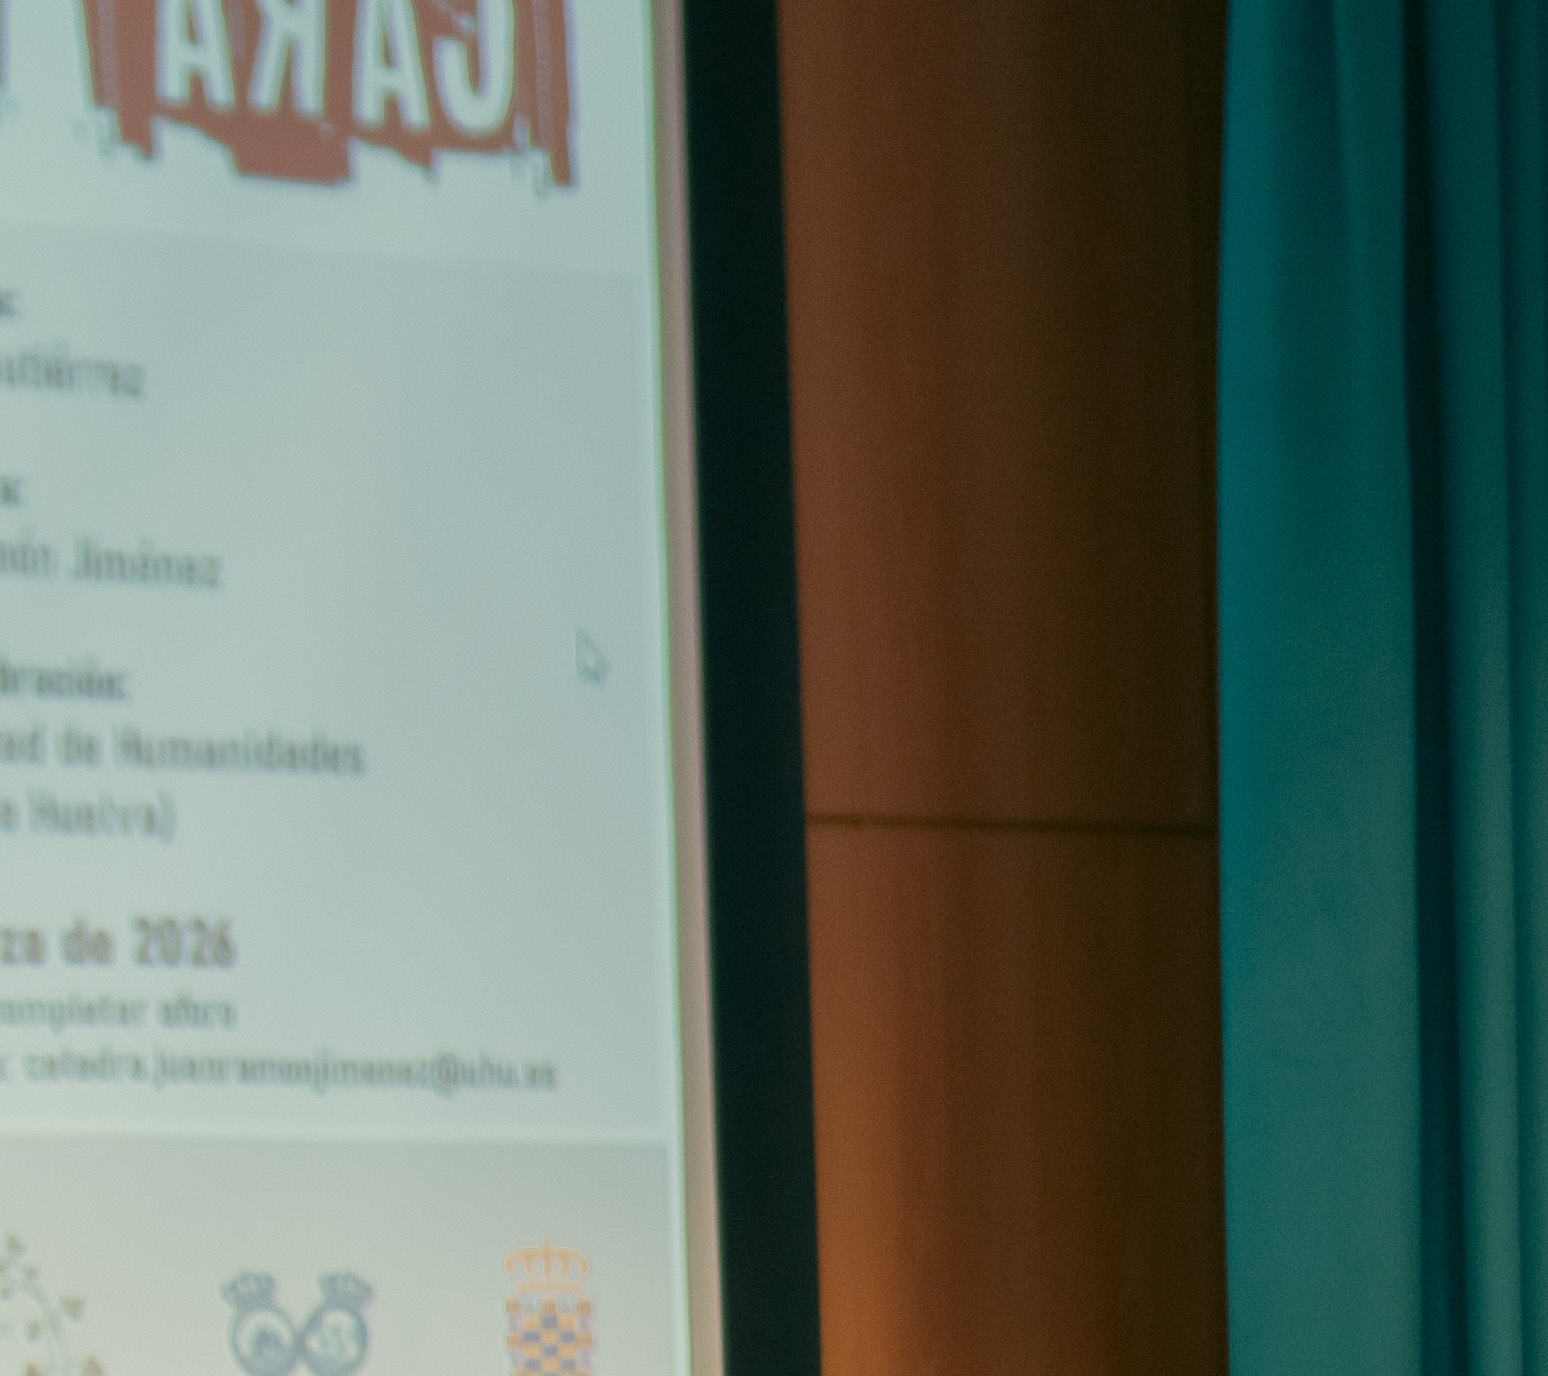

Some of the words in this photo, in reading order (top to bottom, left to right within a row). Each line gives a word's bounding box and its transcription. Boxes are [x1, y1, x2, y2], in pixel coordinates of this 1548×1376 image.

[56, 720, 99, 769] de
[110, 722, 366, 776] Humanidades
[61, 918, 115, 966] de
[132, 916, 238, 968] 2026
